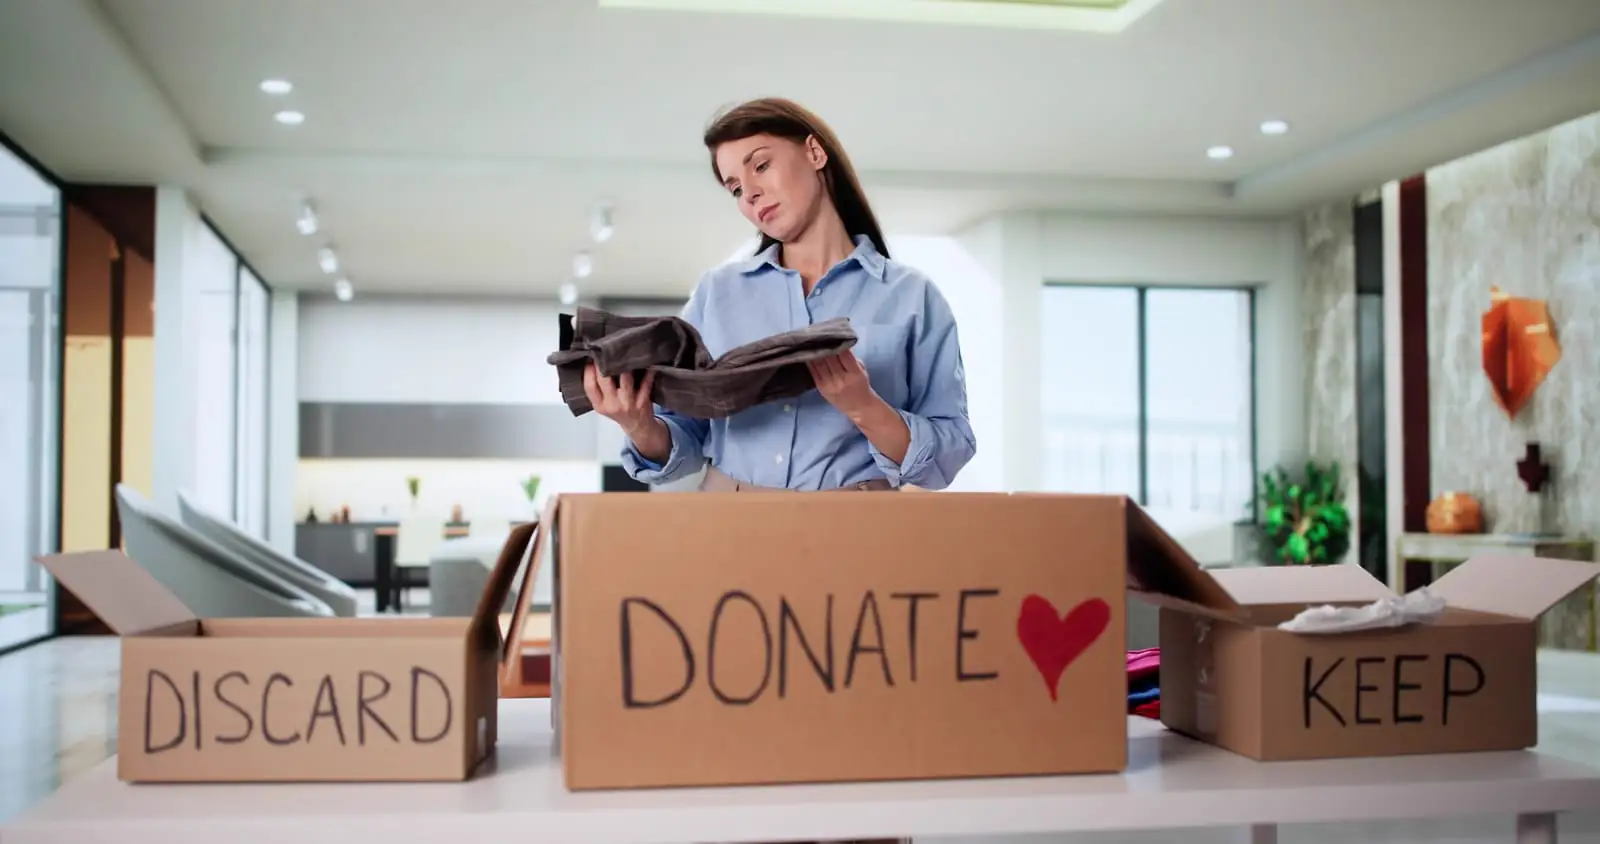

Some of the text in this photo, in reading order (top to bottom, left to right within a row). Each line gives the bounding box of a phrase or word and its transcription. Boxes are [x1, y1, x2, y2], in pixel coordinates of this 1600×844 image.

[621, 589, 1000, 709] DONATE
[1302, 652, 1486, 729] KEEP
[144, 667, 453, 754] DISCARD
